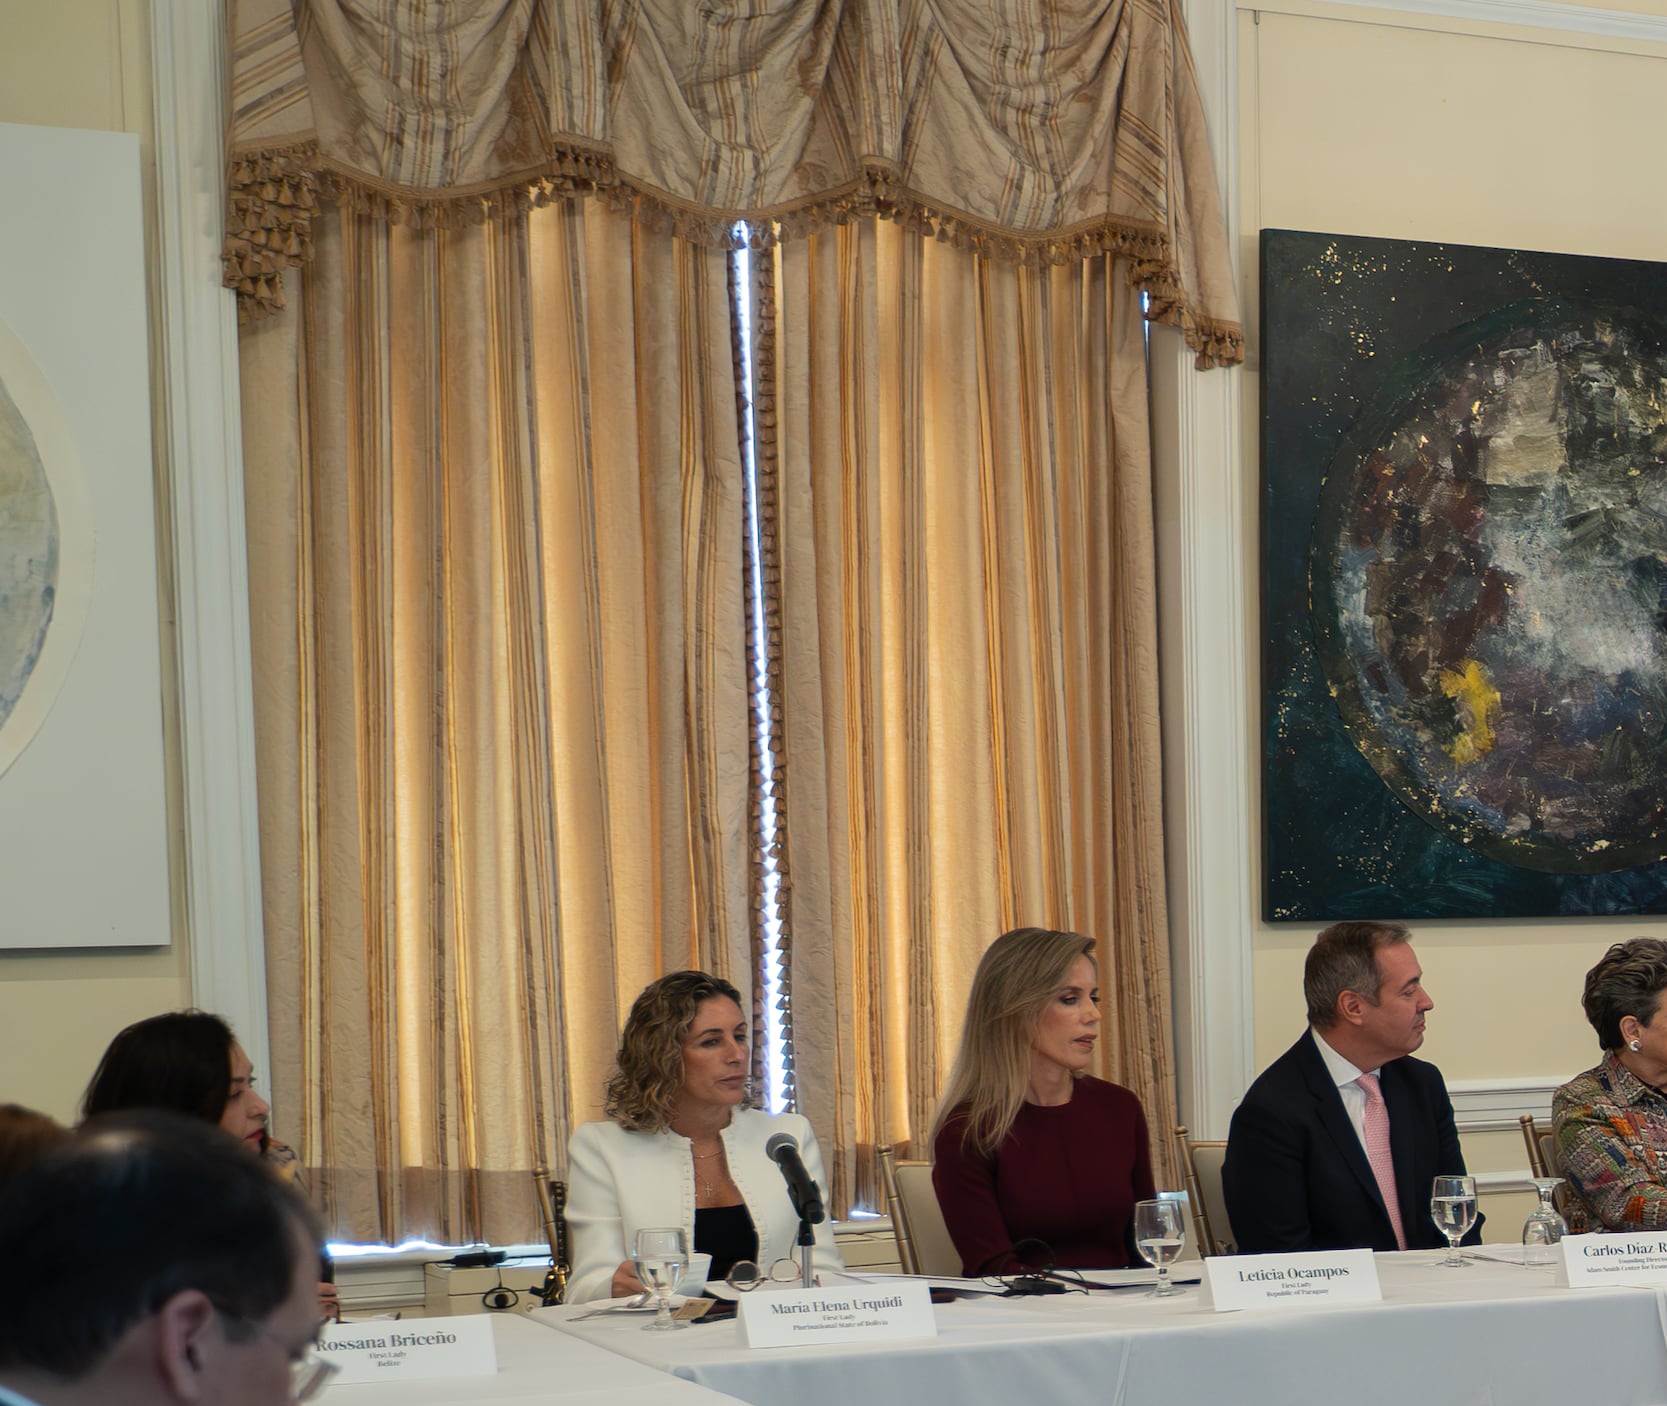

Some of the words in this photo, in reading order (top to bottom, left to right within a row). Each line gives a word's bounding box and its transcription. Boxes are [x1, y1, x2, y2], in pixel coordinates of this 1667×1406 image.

[1583, 1245, 1625, 1257] Carlos
[1238, 1268, 1285, 1282] Leticia
[1287, 1266, 1350, 1281] Ocampos
[813, 1300, 850, 1312] Elena
[853, 1296, 904, 1312] Urquidi
[316, 1336, 386, 1352] Rossana
[391, 1330, 456, 1348] Briceño
